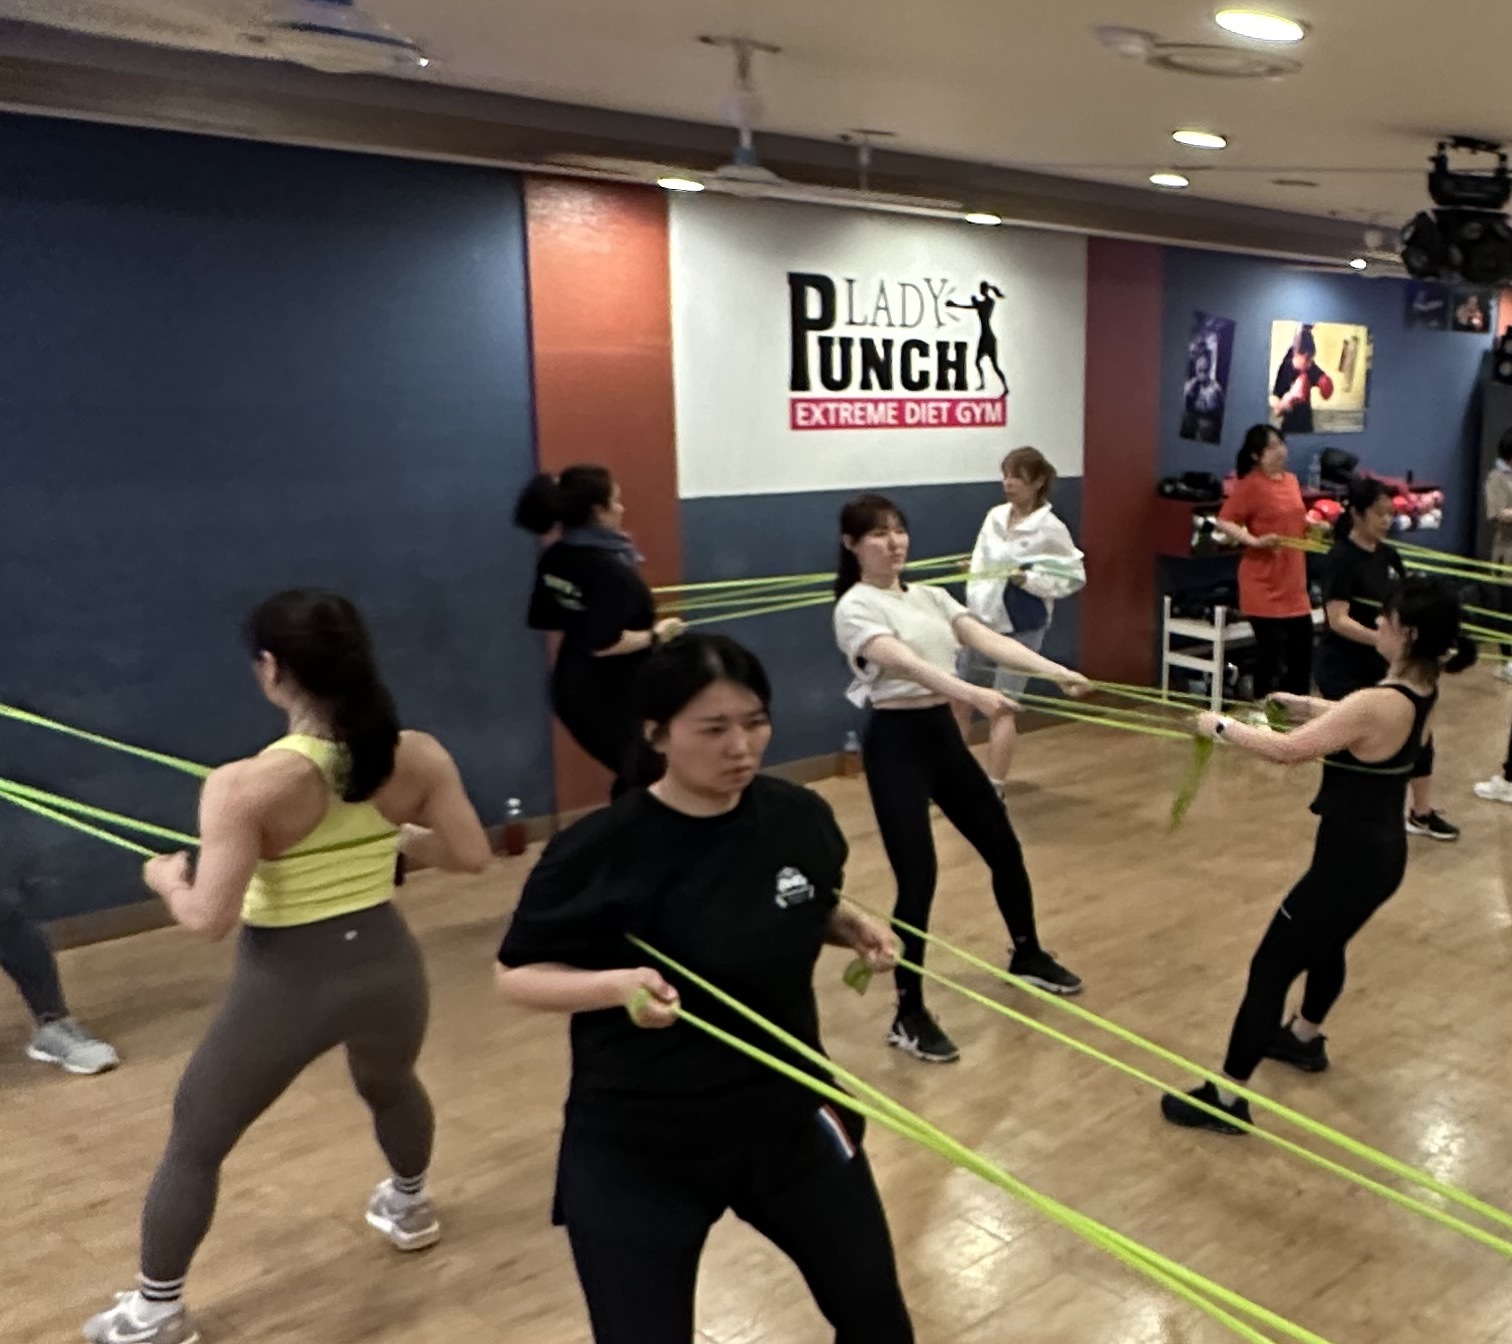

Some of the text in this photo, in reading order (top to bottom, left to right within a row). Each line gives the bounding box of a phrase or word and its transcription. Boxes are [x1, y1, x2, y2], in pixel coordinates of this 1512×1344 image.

[843, 277, 949, 328] LADY
[786, 271, 968, 392] PUNCH
[796, 400, 1003, 426] EXTREME DIET GYM
